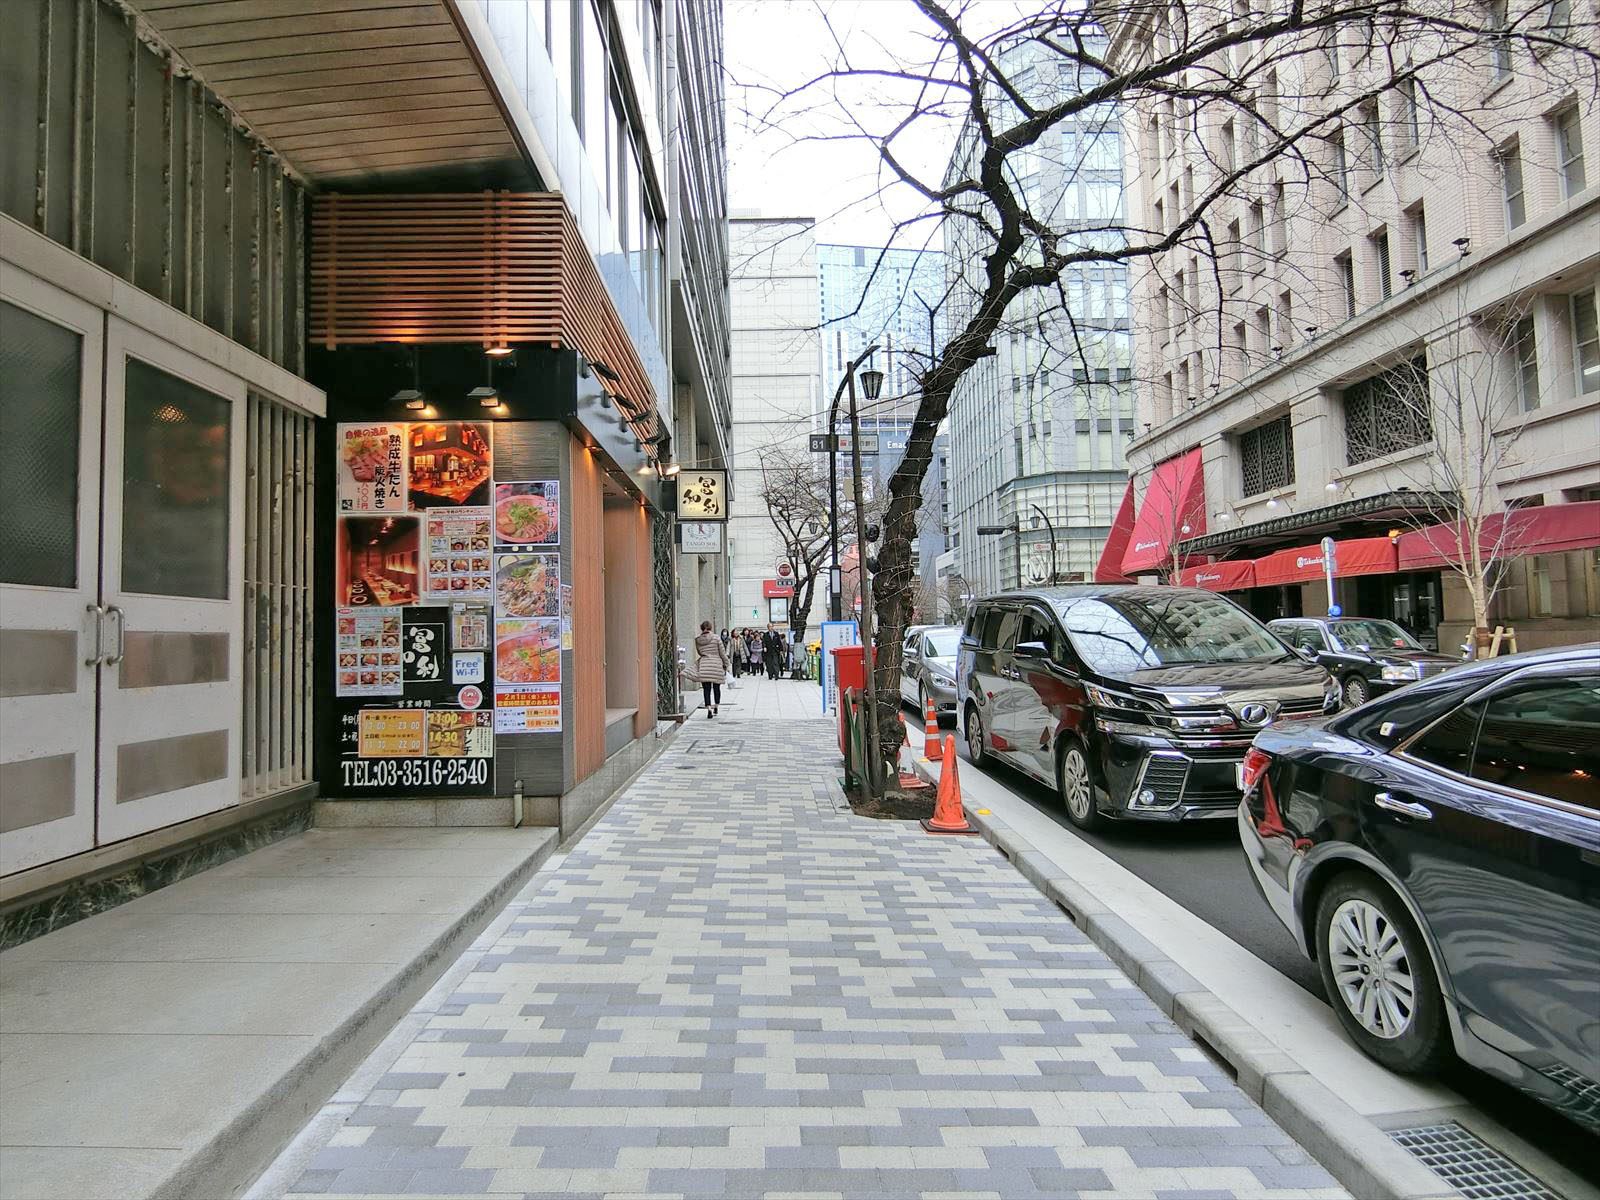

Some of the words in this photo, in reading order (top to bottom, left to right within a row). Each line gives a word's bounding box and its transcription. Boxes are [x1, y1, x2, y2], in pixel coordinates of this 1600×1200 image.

[812, 440, 824, 450] 81
[389, 434, 401, 498] 熟成牛たん
[374, 466, 386, 509] 炭火焼き
[455, 659, 479, 668] Free
[455, 669, 479, 677] Wi-Fi
[398, 700, 431, 708] 営業時間
[429, 731, 458, 743] 14:30
